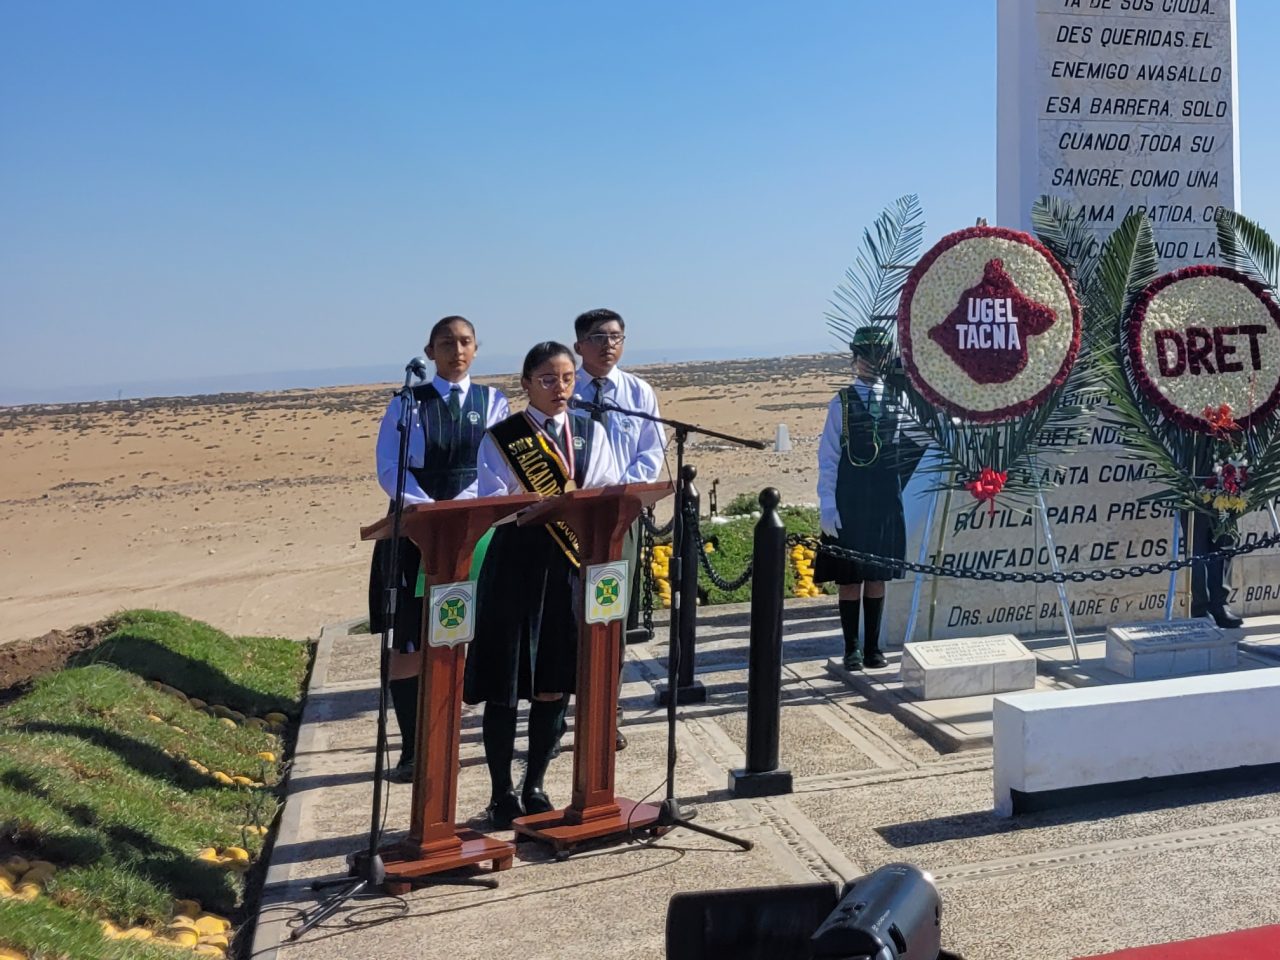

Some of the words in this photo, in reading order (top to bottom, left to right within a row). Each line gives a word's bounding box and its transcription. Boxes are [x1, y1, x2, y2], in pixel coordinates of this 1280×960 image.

[1056, 25, 1093, 44] DES
[1191, 31, 1213, 49] EL
[1051, 61, 1129, 80] ENEMIGO
[1136, 64, 1222, 83] AVASALLO
[1046, 96, 1081, 114] ESA
[1181, 100, 1228, 118] SOLO
[1058, 132, 1130, 152] CUANDO
[1139, 134, 1181, 152] TODA
[1190, 135, 1215, 153] SU
[1130, 169, 1180, 188] COMO
[1186, 170, 1219, 188] UNA
[967, 297, 1018, 323] UGEL
[955, 323, 1021, 350] TACNA
[1154, 324, 1267, 378] DRET
[954, 509, 1033, 531] RUTILA
[1046, 504, 1098, 525] PARA
[1089, 541, 1120, 561] DE
[1126, 538, 1168, 558] LOS
[987, 604, 1036, 623] JORGE
[1039, 598, 1106, 619] BAADRE
[1139, 594, 1169, 610] JOS
